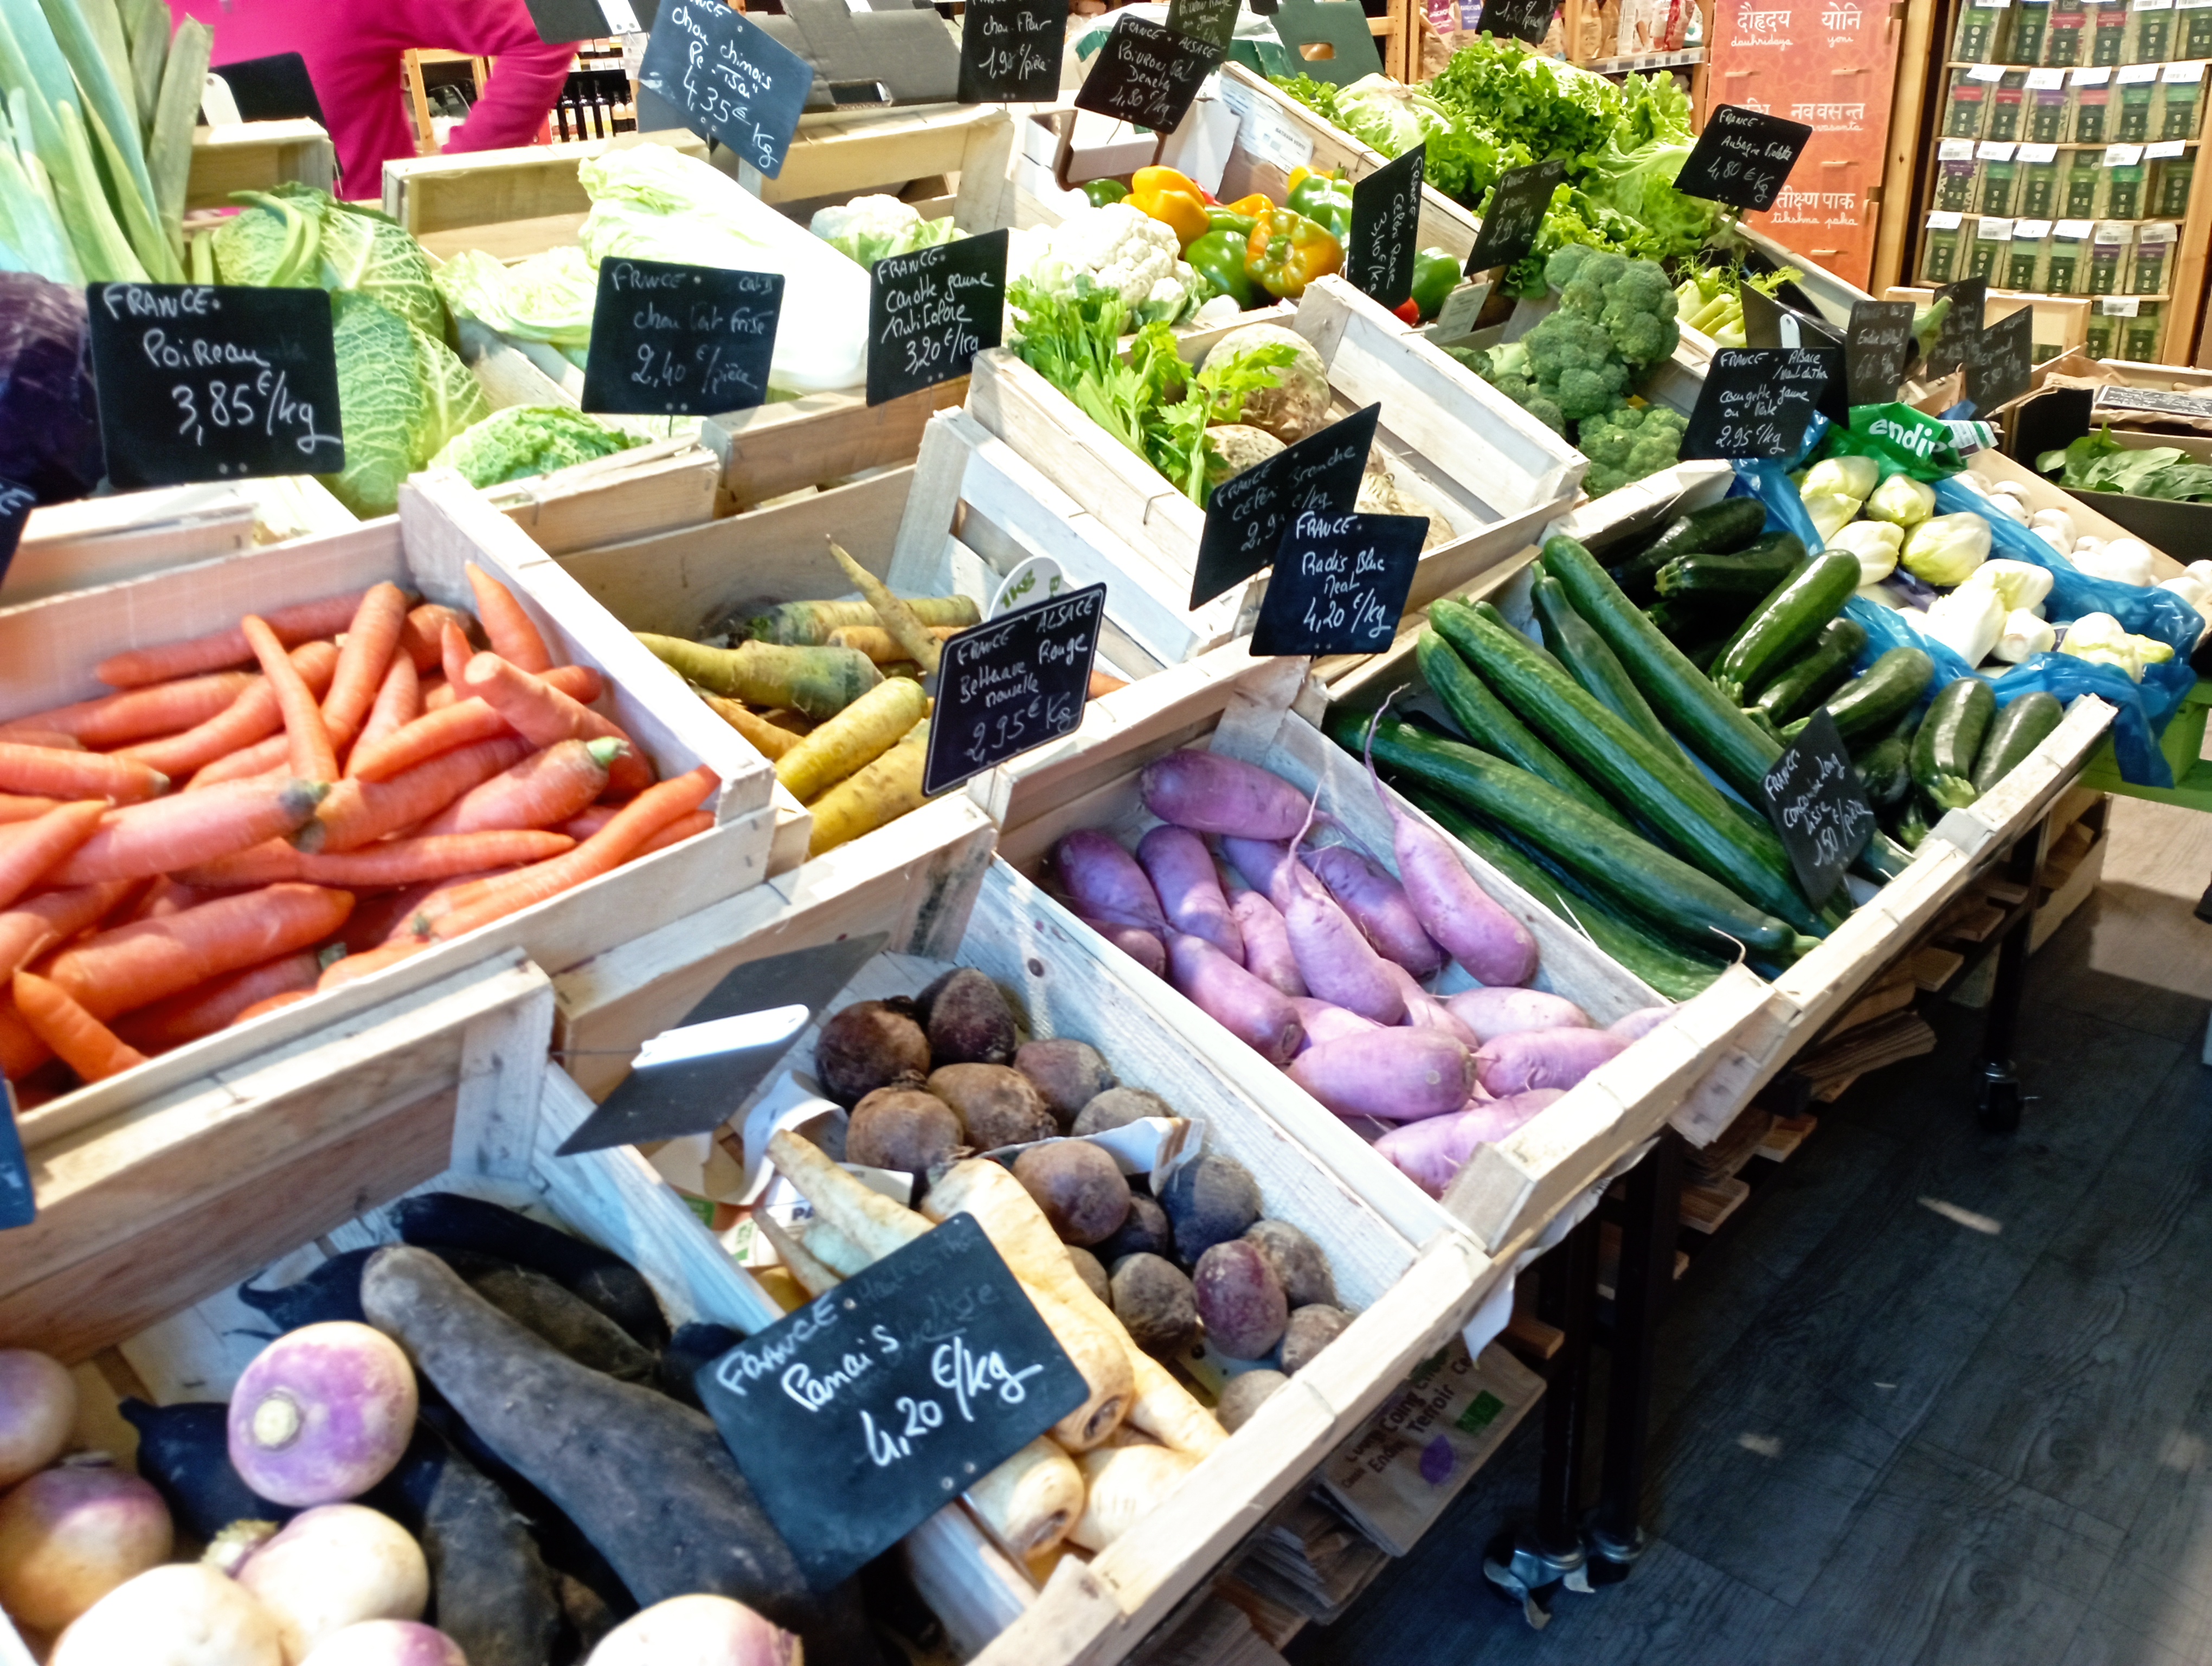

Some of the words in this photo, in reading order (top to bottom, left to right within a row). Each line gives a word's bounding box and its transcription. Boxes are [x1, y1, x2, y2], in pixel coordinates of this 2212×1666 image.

[1821, 2, 1862, 30] योनि
[1827, 33, 1854, 49] yoni
[1822, 192, 1856, 210] पाक
[612, 262, 686, 291] FRANCE
[878, 247, 944, 285] FRANCE
[104, 283, 214, 321] FRANCE
[1720, 351, 1769, 367] FRANCE
[1217, 458, 1277, 507] FRANCE
[1296, 510, 1359, 540] FRANCE
[1303, 549, 1347, 575] Radis
[957, 625, 1016, 665] FRANCE
[1036, 595, 1094, 633] ALSACE
[1039, 633, 1088, 665] Rouge
[717, 1291, 839, 1396] FRANCE
[1406, 1383, 1455, 1433] Terroir
